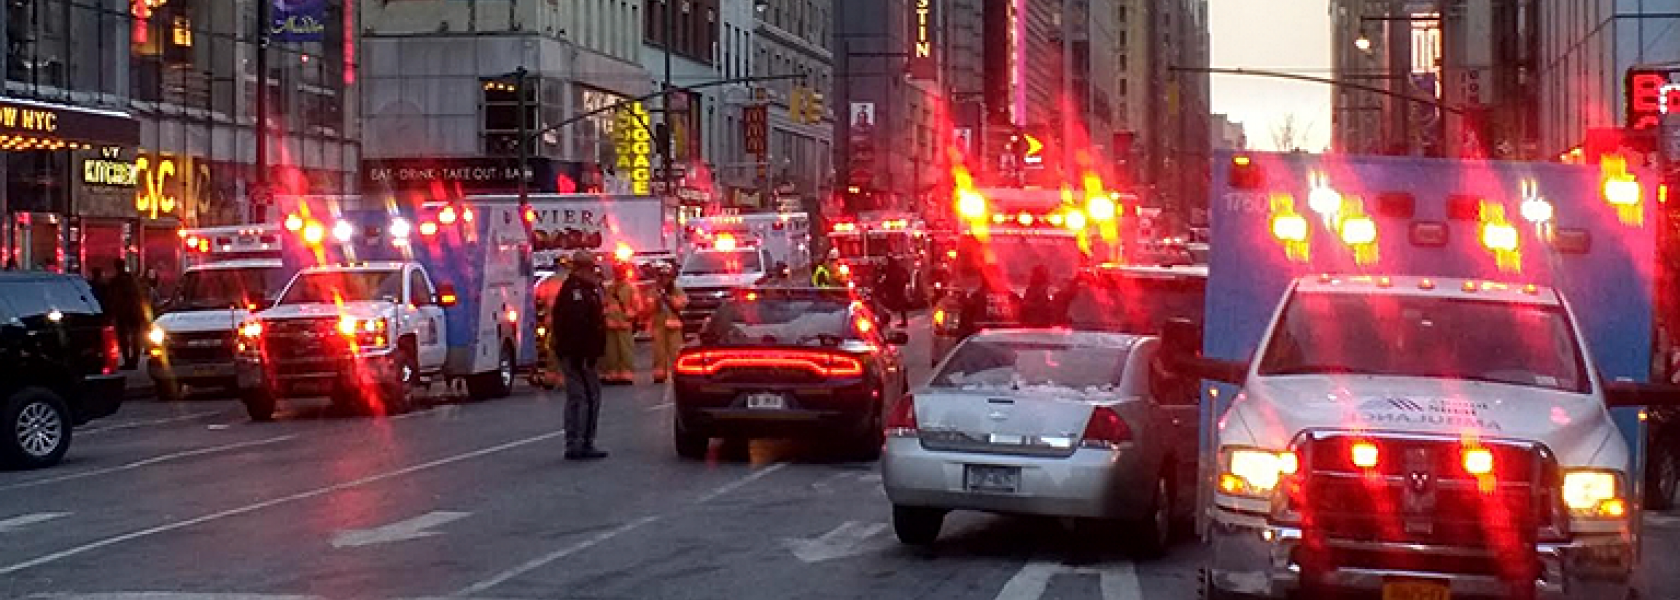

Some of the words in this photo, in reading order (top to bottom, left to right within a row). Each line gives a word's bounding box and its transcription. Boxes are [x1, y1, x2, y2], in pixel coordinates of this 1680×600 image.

[0, 106, 17, 127] W
[22, 109, 57, 132] NYC
[632, 100, 651, 195] LUGGAGE
